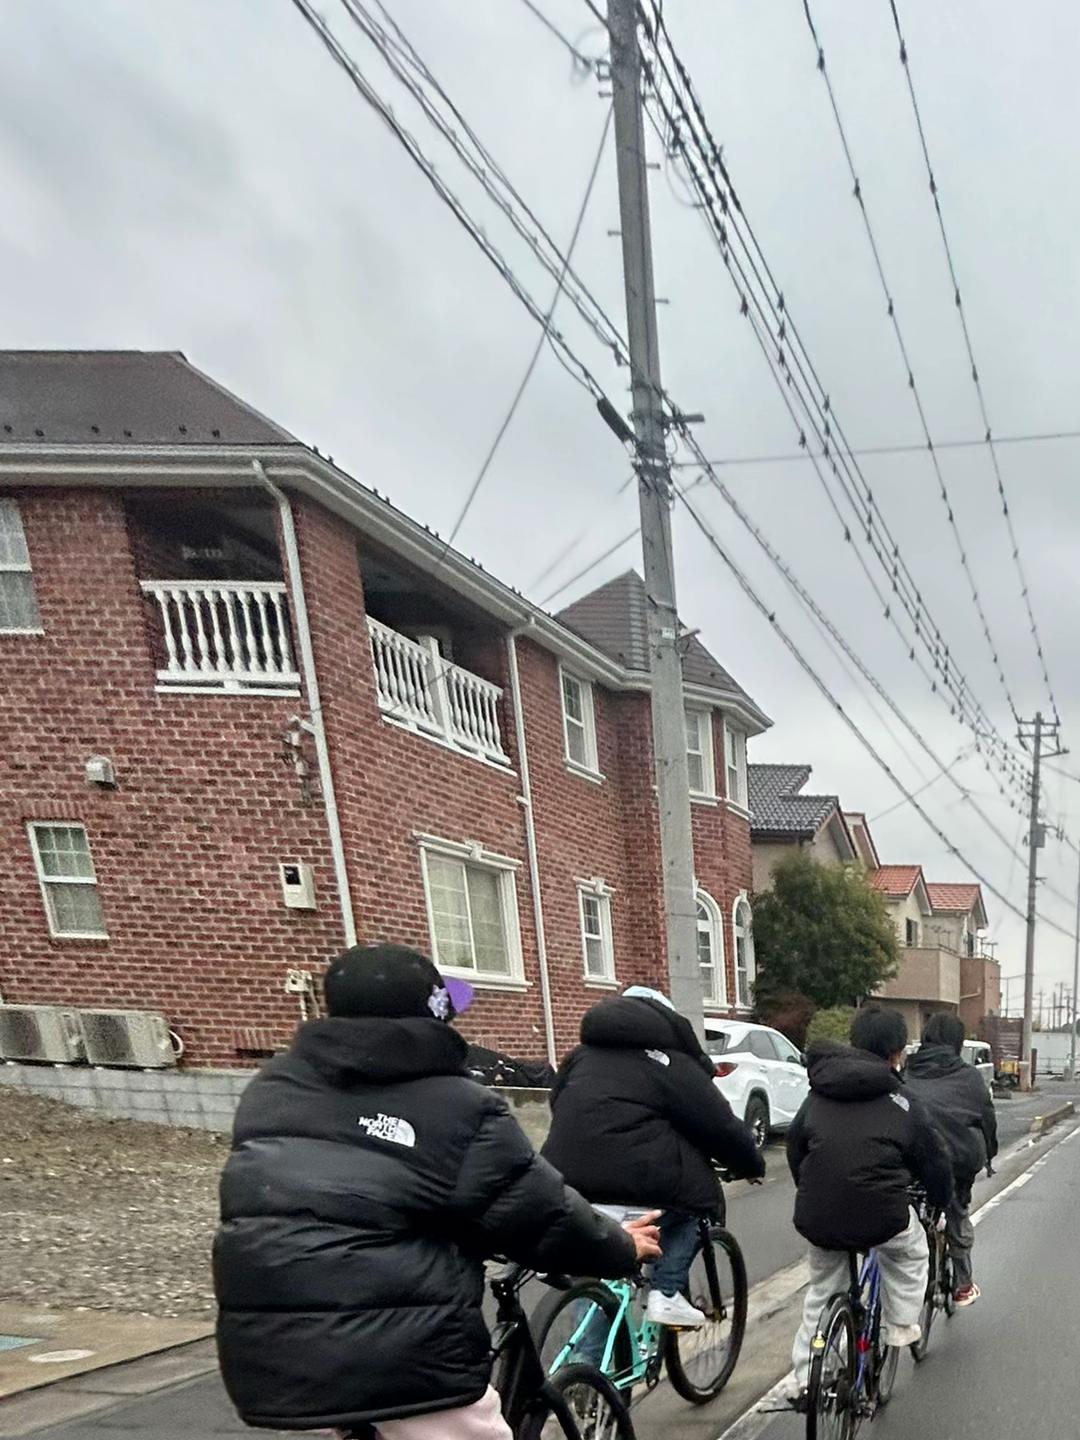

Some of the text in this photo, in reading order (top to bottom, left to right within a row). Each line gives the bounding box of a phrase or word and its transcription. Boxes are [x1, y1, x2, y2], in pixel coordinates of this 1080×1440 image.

[358, 1116, 398, 1134] NORTH
[377, 1112, 399, 1126] THE
[366, 1127, 398, 1141] FACE
